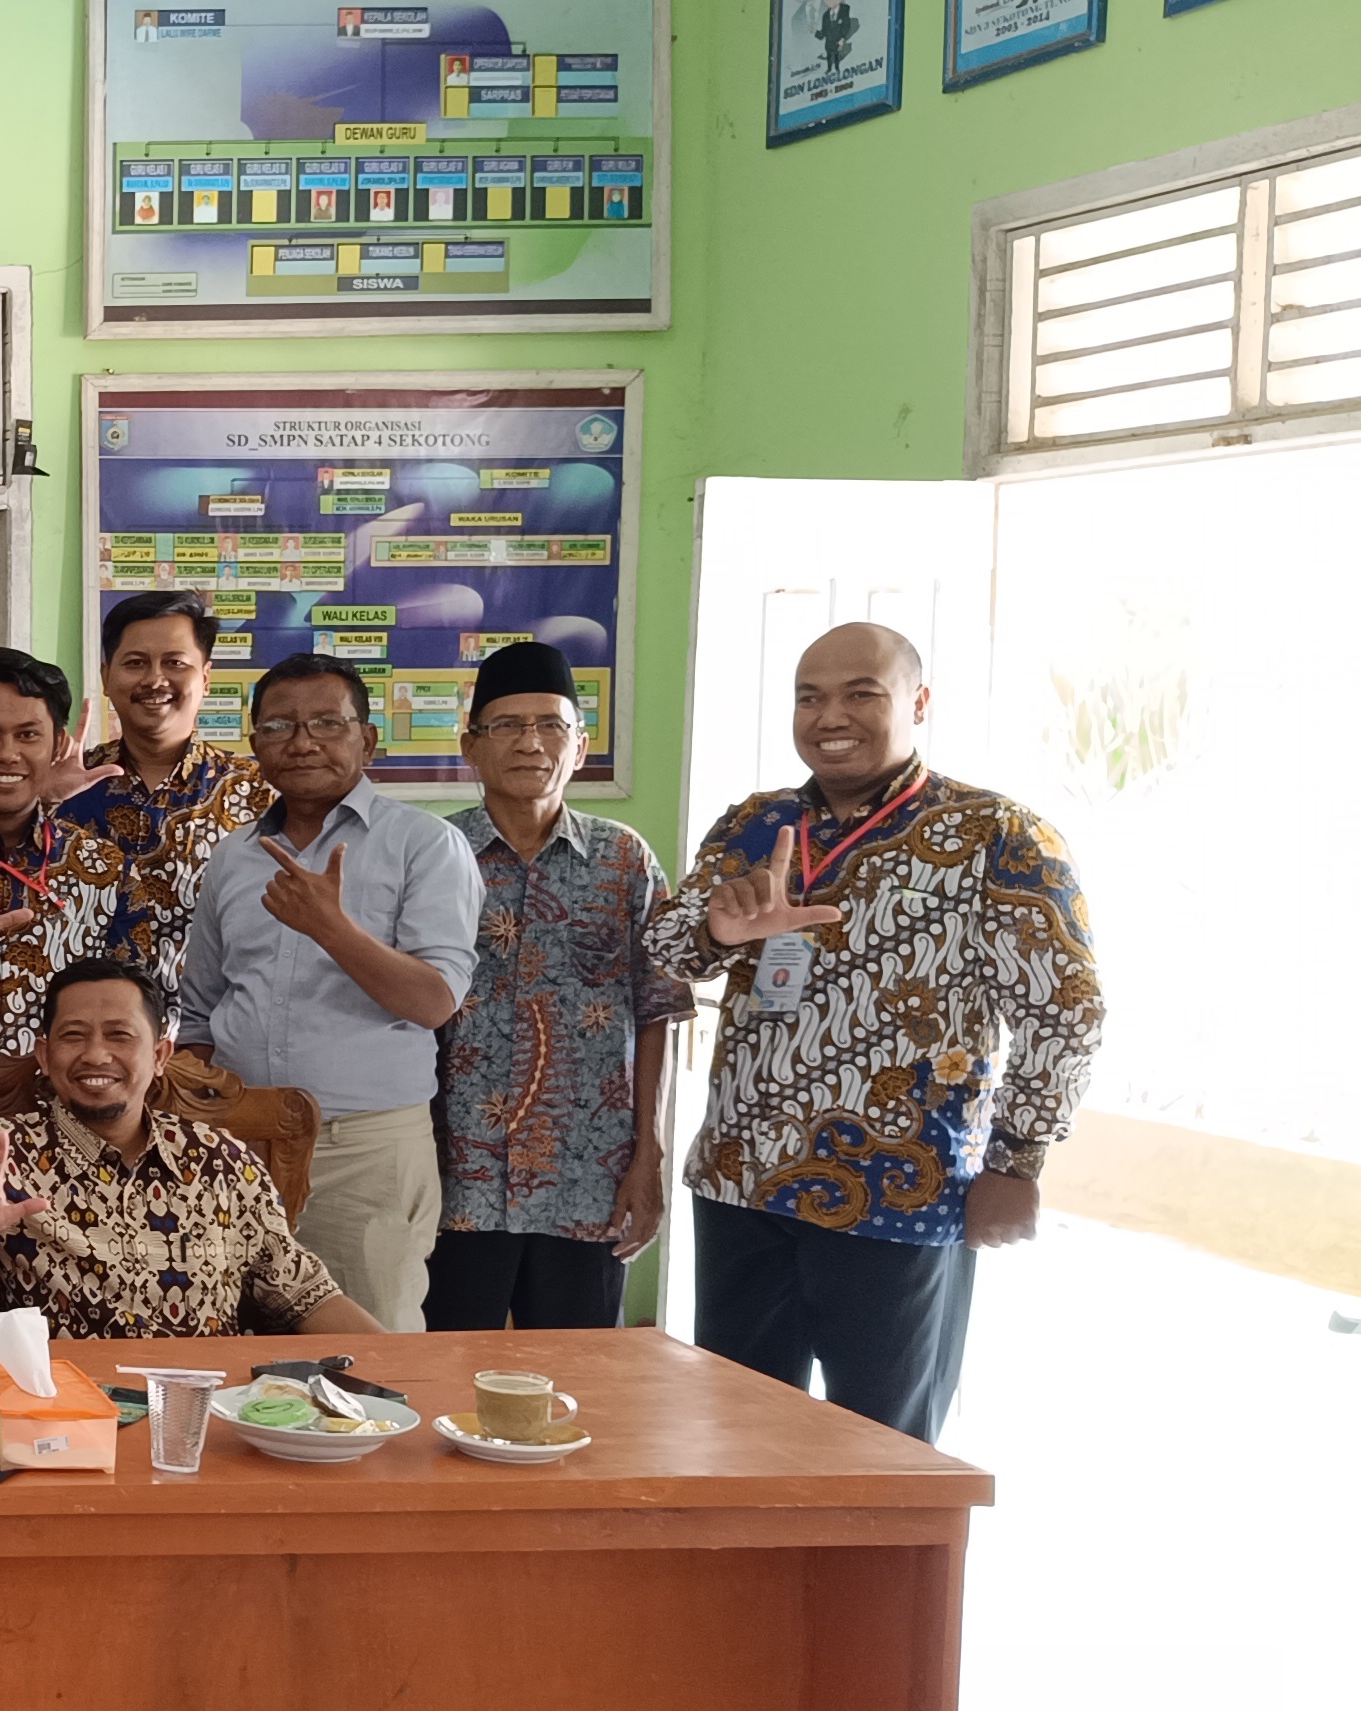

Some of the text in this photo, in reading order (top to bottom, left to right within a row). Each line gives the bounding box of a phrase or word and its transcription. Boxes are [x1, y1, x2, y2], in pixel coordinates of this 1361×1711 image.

[170, 12, 215, 24] KOMITE
[345, 127, 416, 140] DEWAN GURU
[352, 278, 404, 290] SISWA
[273, 420, 422, 432] STRUKTUR ORGANISASI
[226, 433, 492, 451] SD_SMPN SATAP 4 SEKOTONG
[458, 515, 519, 523] WAKA URUSAN
[321, 610, 387, 622] WALI KELAS
[354, 635, 373, 643] KELAS
